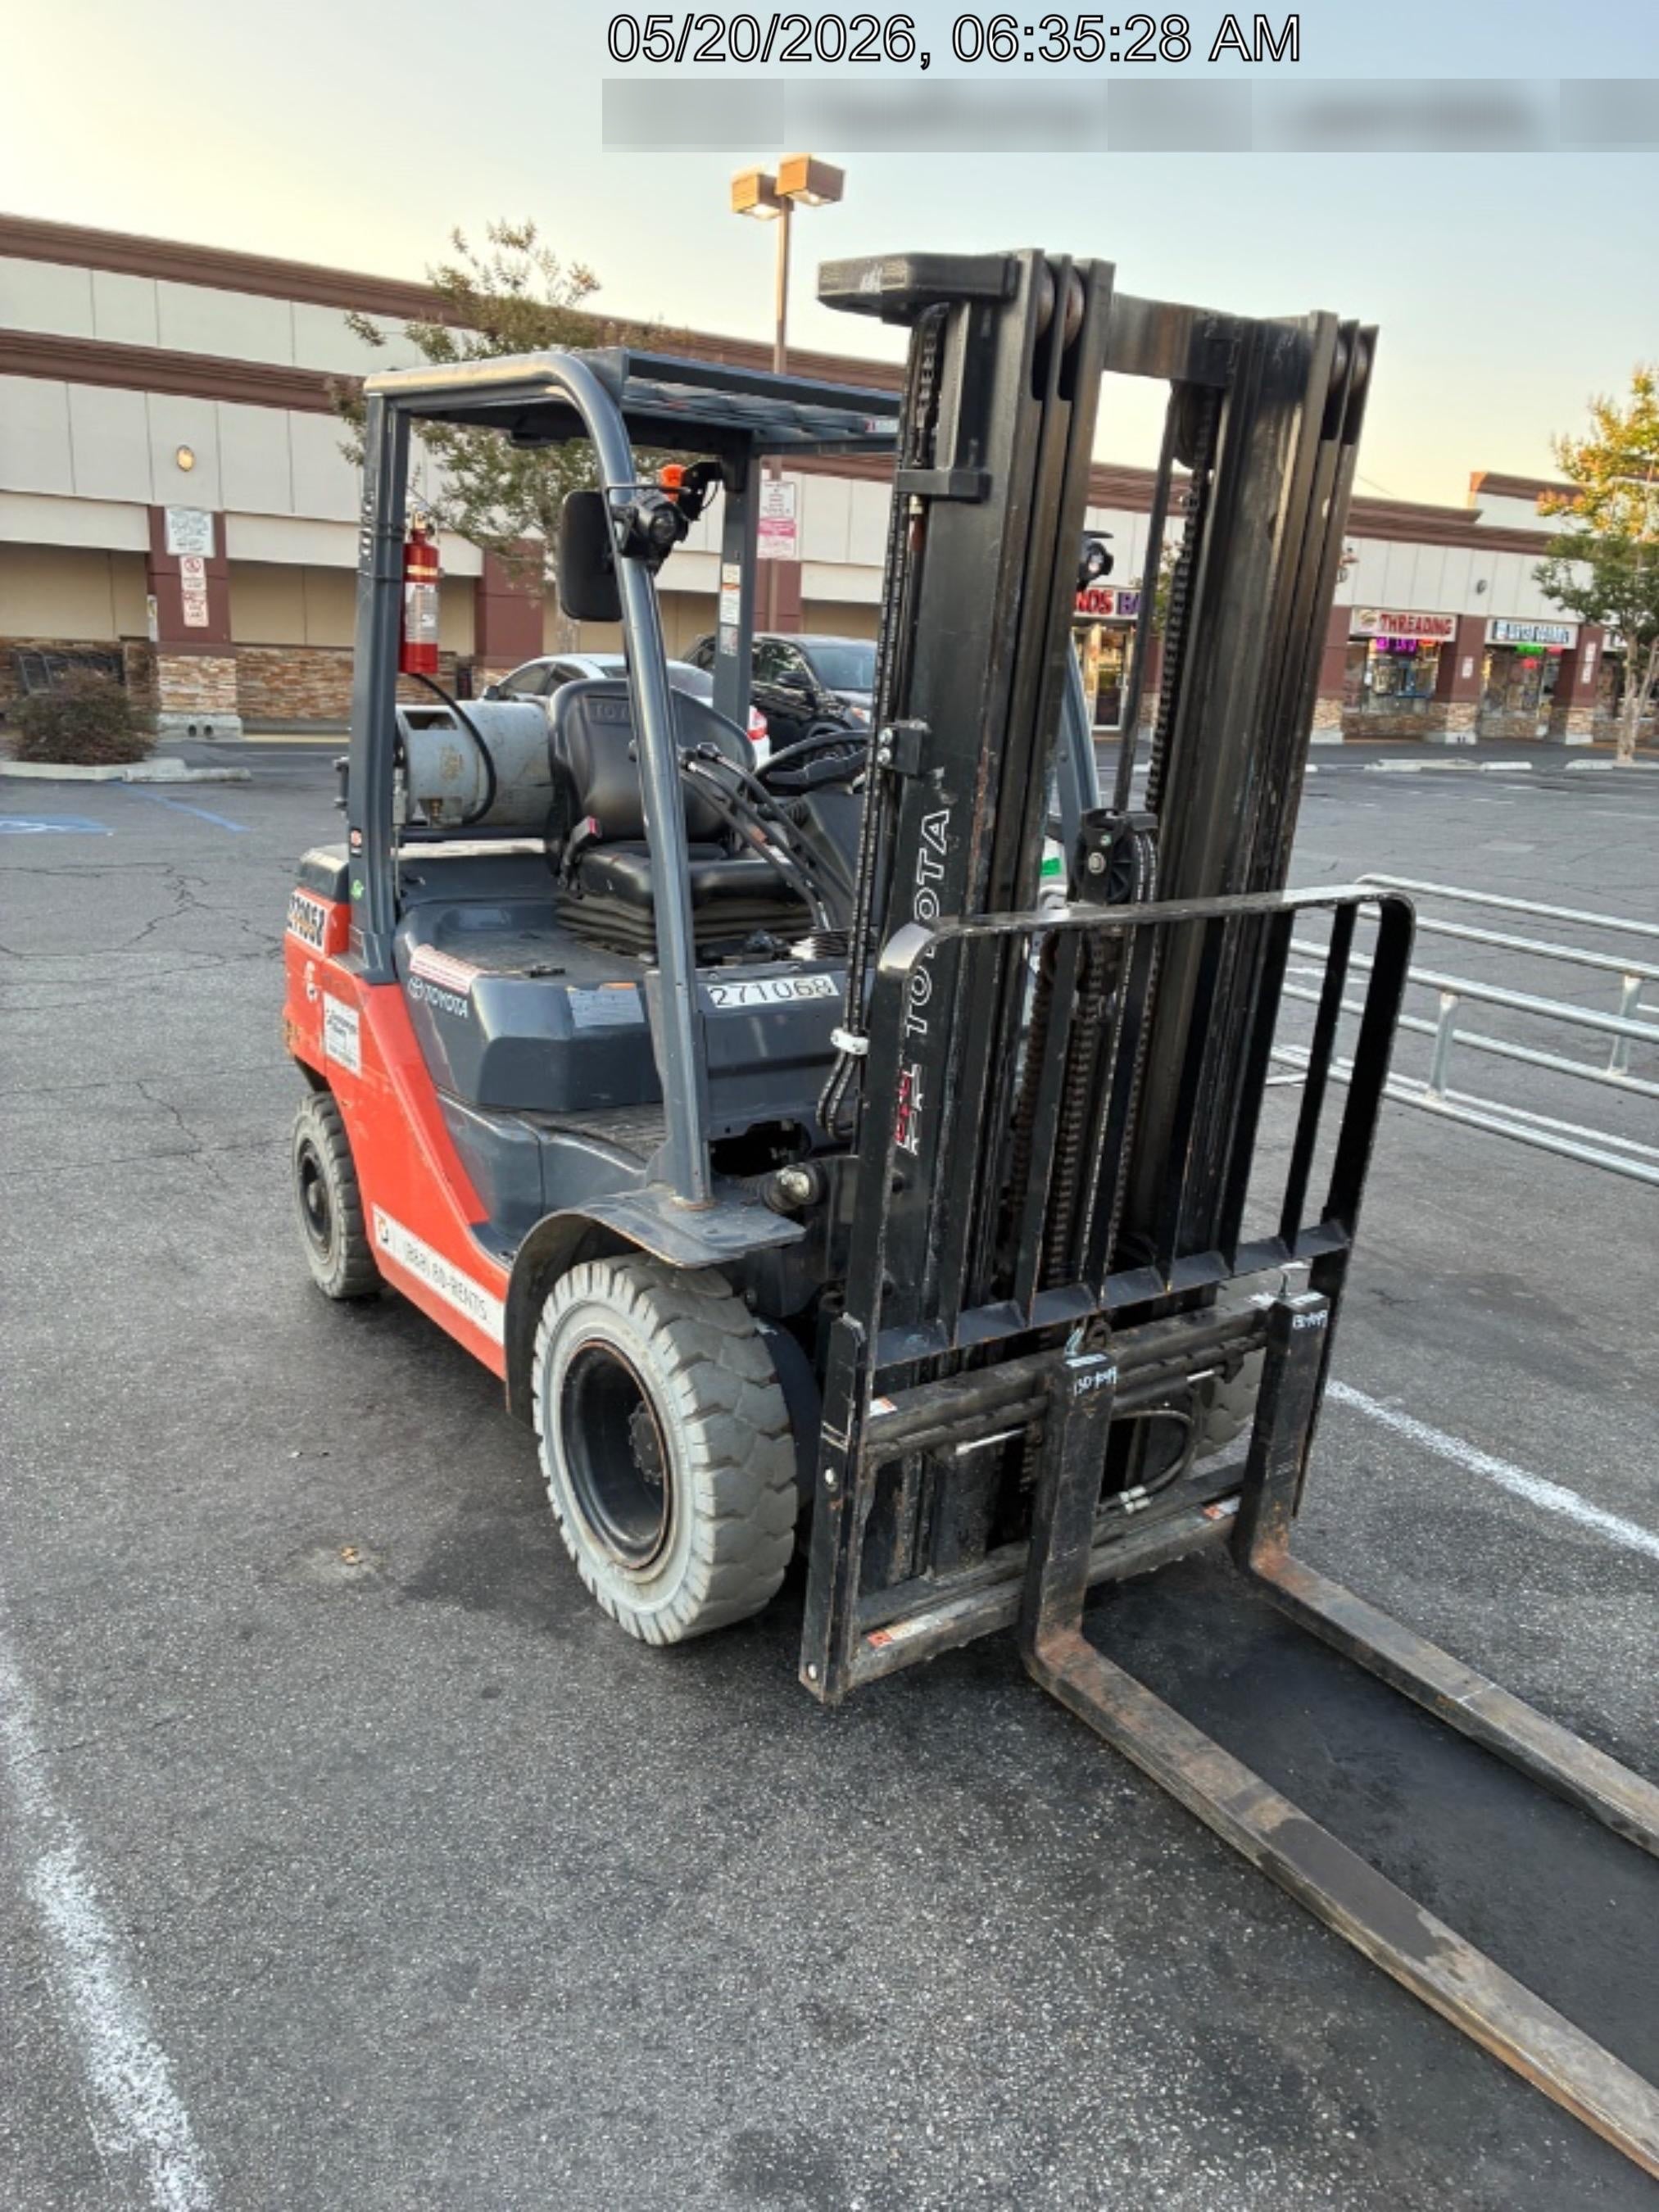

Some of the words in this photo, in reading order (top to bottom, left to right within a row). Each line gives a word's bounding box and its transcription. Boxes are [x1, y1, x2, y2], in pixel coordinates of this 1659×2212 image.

[1380, 613, 1452, 635] THREADING
[905, 808, 950, 1038] TOOTA
[425, 984, 468, 1018] TOYOTA
[709, 977, 832, 1007] 271068
